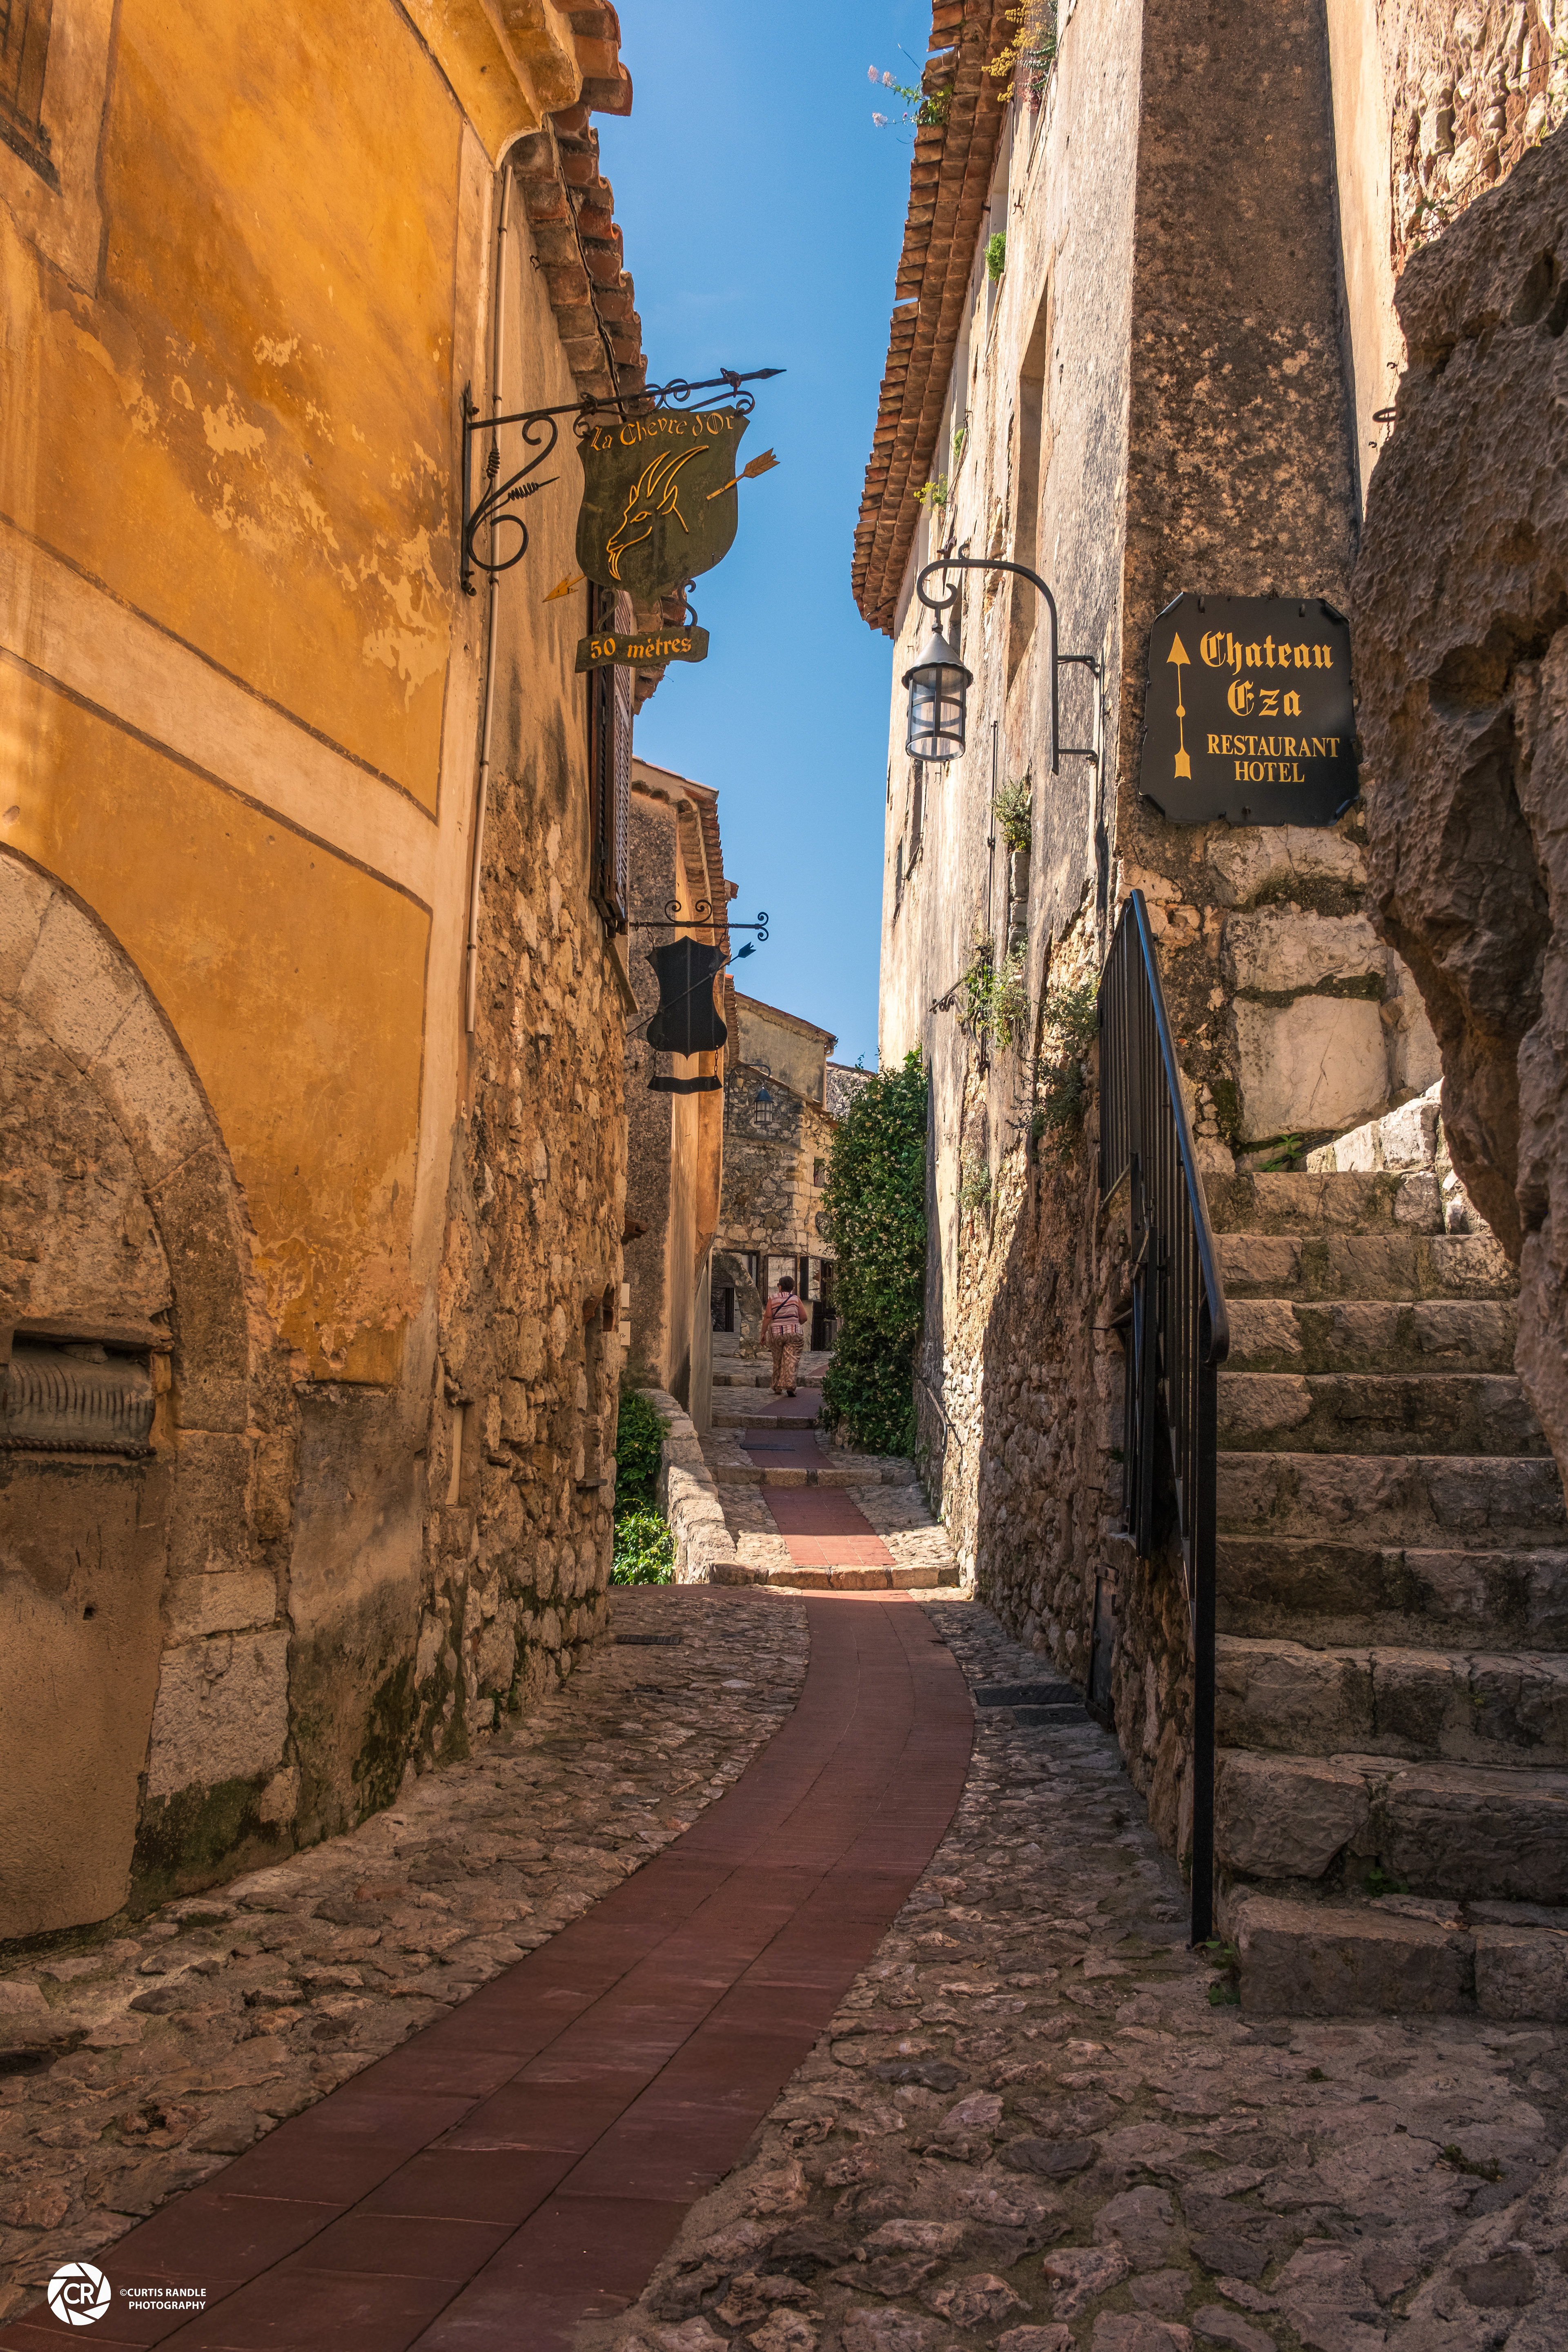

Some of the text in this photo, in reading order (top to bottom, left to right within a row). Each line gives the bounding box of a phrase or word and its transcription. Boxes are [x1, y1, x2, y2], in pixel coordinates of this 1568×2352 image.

[590, 412, 734, 451] La Chevre d'Or
[591, 638, 615, 659] 50
[1200, 631, 1334, 675] Chateau
[1227, 679, 1302, 716] Eza
[1207, 734, 1340, 757] RESTAURANT
[1234, 761, 1305, 782] HOTEL
